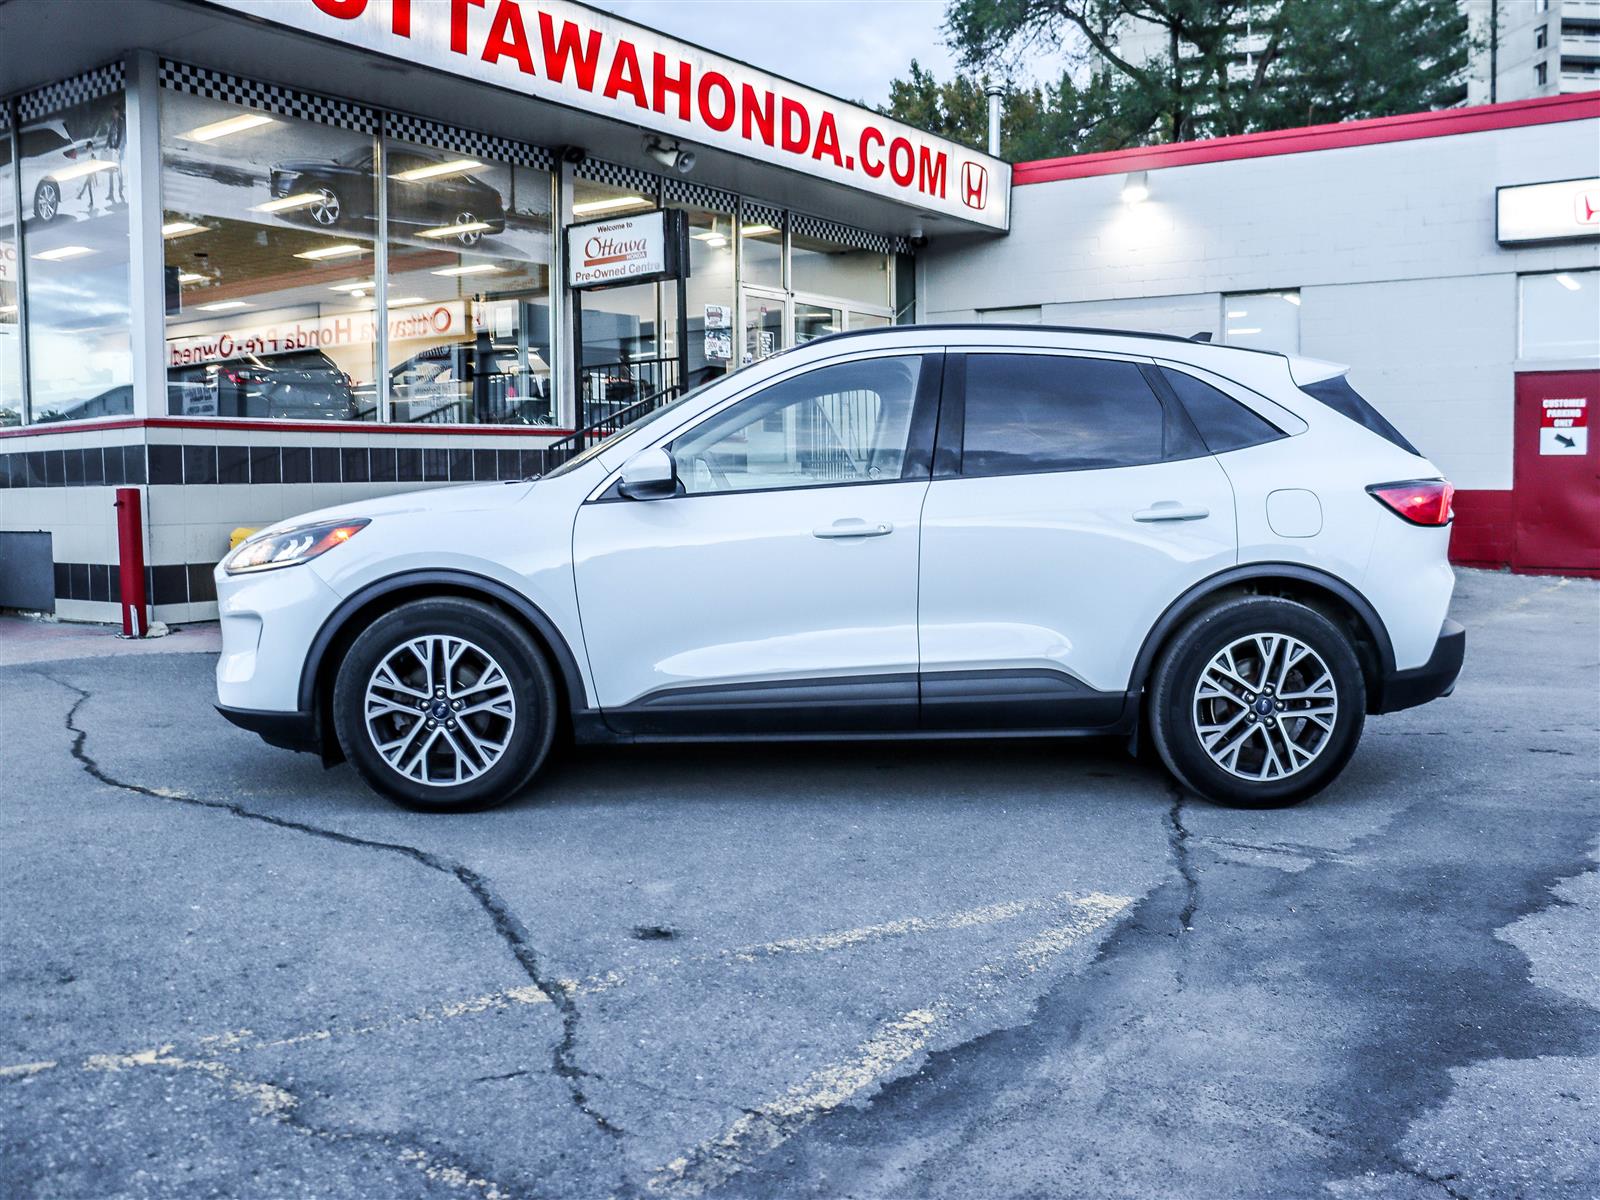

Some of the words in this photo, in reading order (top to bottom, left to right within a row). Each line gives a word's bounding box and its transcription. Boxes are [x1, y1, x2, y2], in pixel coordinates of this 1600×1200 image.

[312, 0, 947, 199] TAWAHONDA.COM
[597, 223, 625, 233] Welcome
[585, 236, 647, 259] Ottawa
[575, 265, 626, 281] Pre-Owned
[628, 261, 661, 273] Centre
